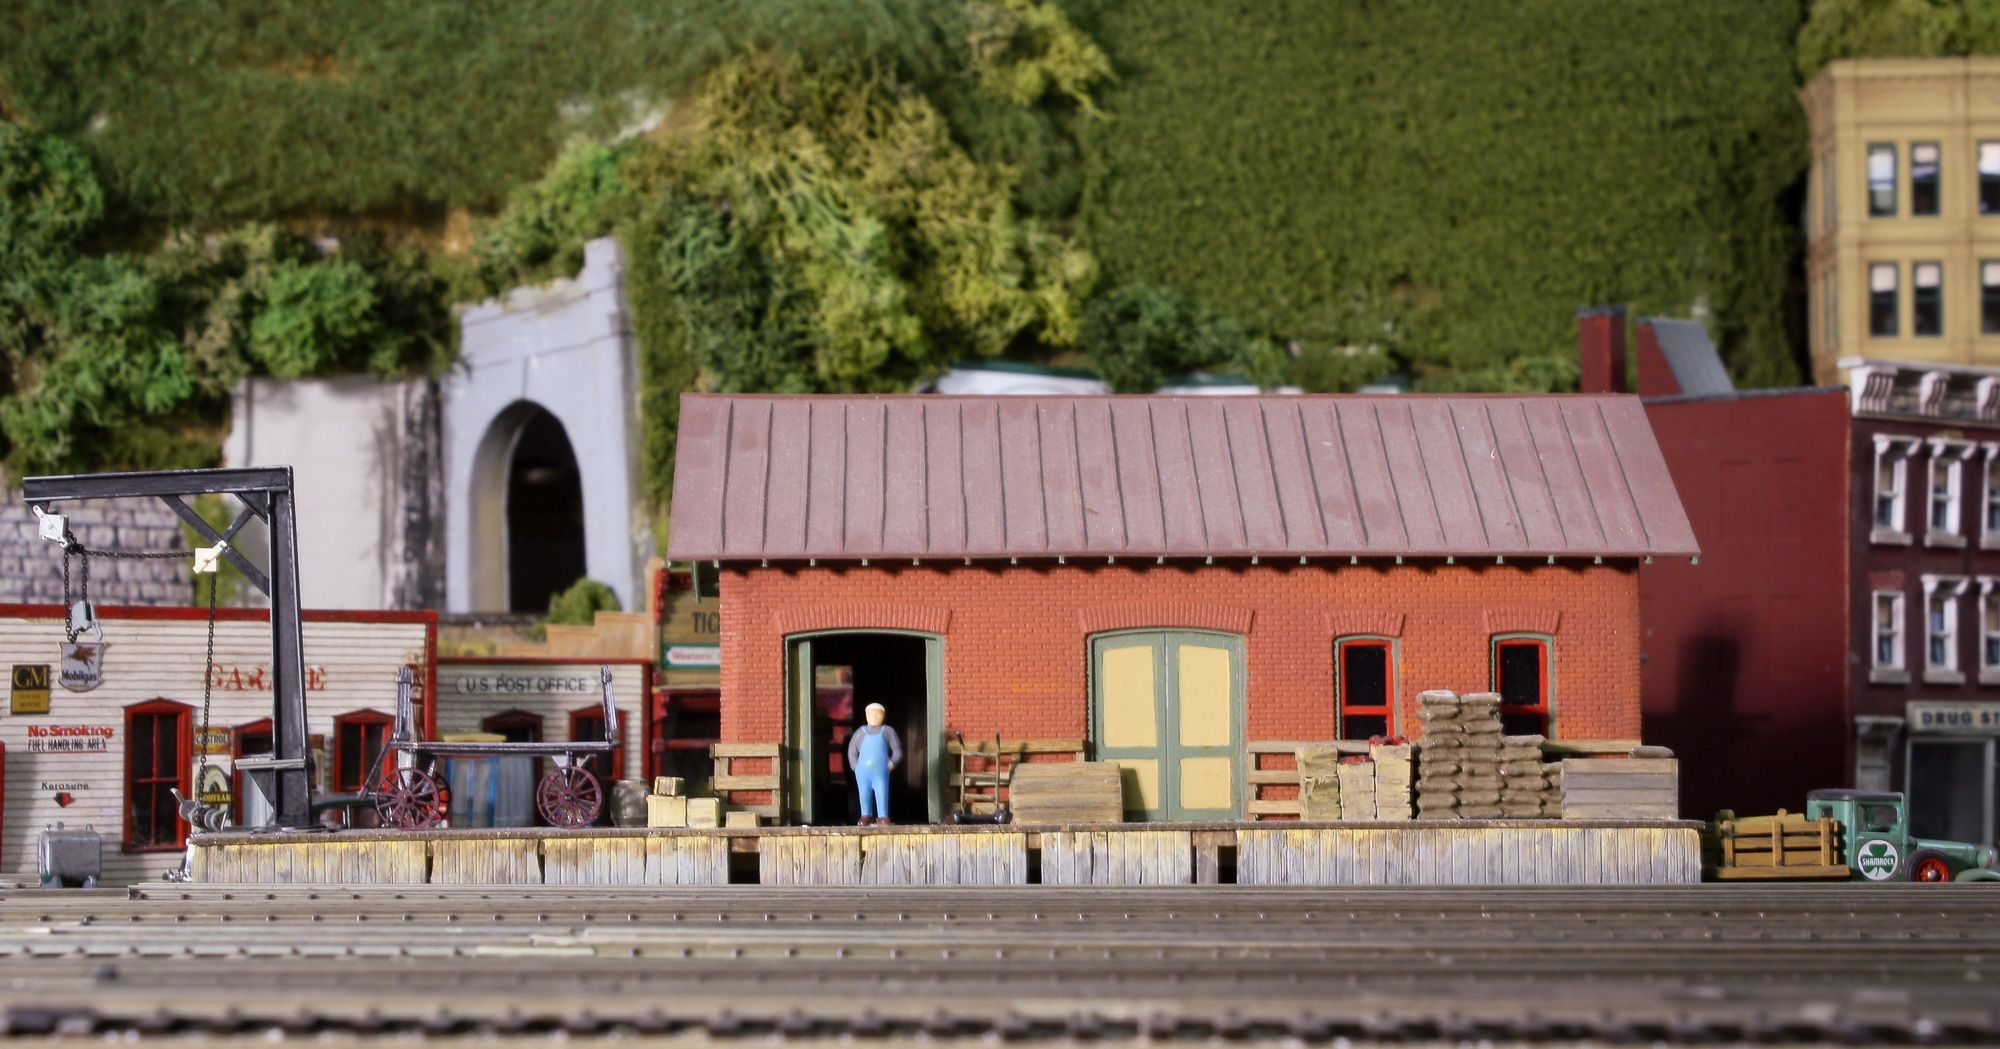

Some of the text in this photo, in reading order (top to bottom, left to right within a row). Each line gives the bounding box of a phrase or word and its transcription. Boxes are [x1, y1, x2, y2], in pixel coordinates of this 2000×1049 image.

[692, 611, 720, 634] TIC
[14, 666, 48, 688] GM
[61, 669, 97, 685] Mobilgas
[205, 663, 325, 691] GARE
[466, 677, 587, 693] U.S. POST OFFICE
[1921, 711, 1973, 725] DRUG
[27, 724, 113, 739] No Smoking
[28, 739, 45, 751] FUEL
[48, 738, 84, 751] HANDLING
[196, 734, 228, 745] CSTROL
[41, 780, 89, 790] Kerosene
[1862, 857, 1895, 866] SHAMROCK
